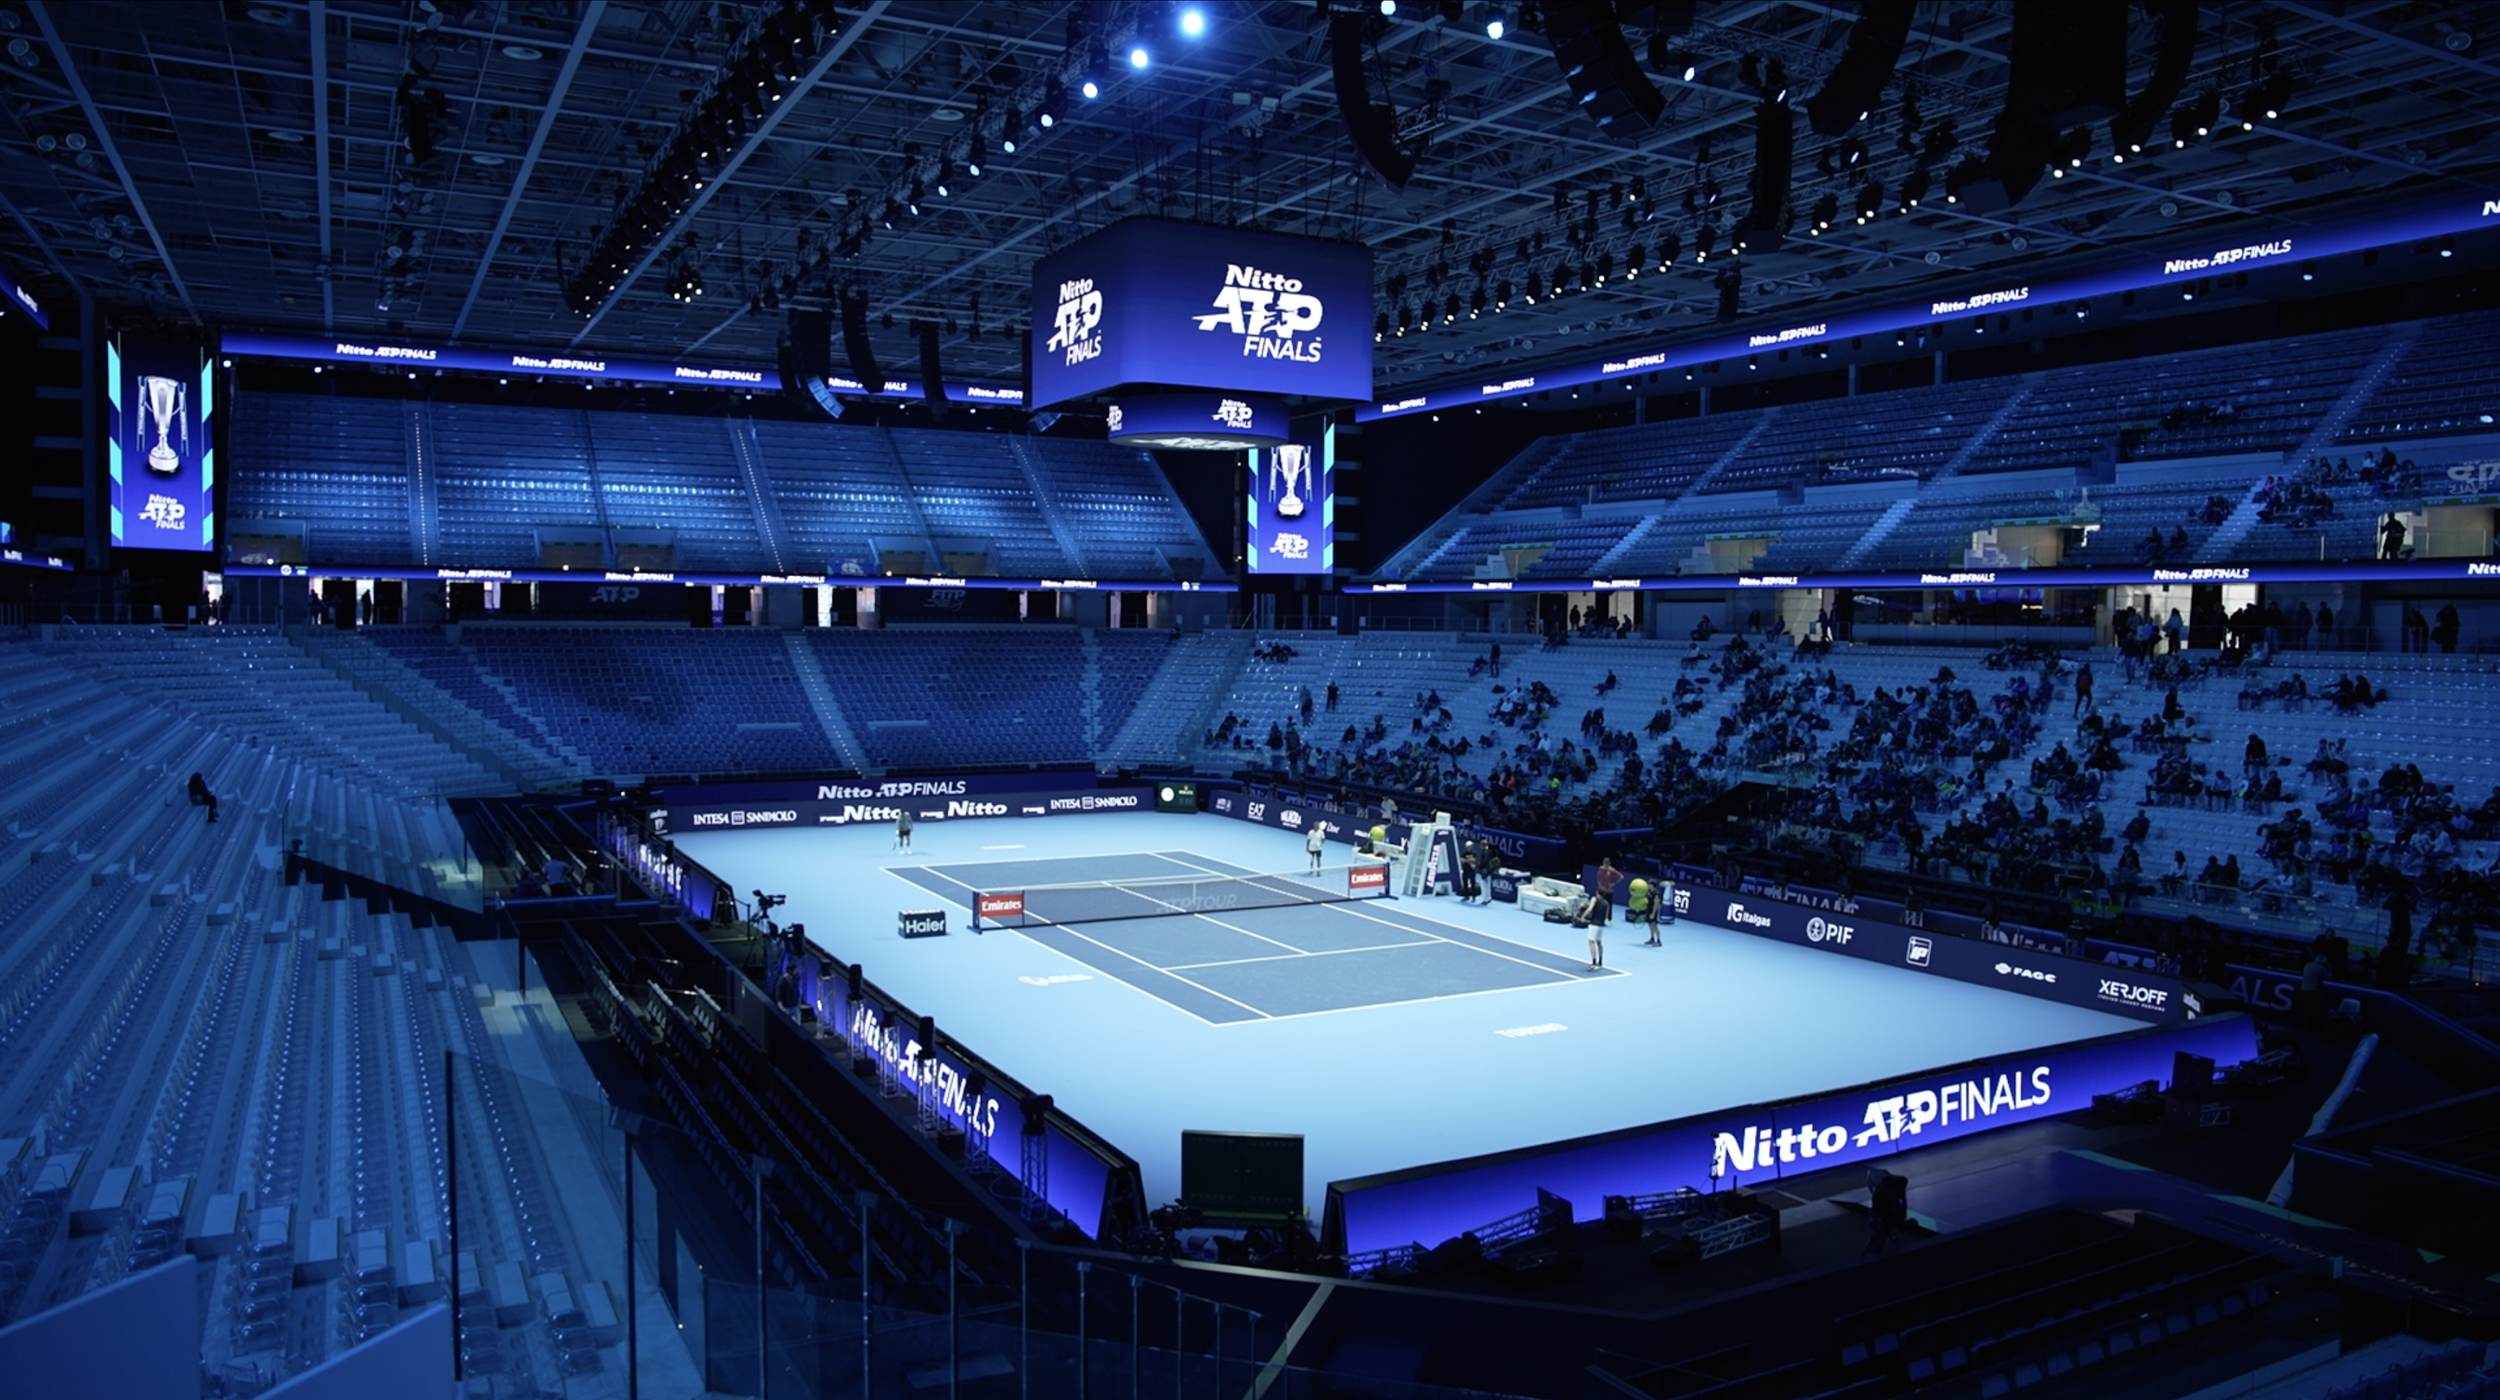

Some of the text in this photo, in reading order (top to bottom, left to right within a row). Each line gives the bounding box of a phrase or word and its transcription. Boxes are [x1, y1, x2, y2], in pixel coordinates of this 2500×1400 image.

[2165, 239, 2291, 275] Nitto ATP FINALS
[1225, 264, 1303, 293] Nitto
[1059, 278, 1094, 304] Nitto
[1932, 287, 2028, 315] Nitto ATP FINALS
[1192, 285, 1324, 338] ATP
[1046, 289, 1103, 353] ATP
[1750, 335, 1777, 348] Nitto
[1798, 323, 1826, 339] FINALS
[336, 343, 437, 360] Nitto ATP FINALS
[1066, 333, 1102, 366] FINALS
[1243, 336, 1322, 363] FINALS
[512, 356, 606, 372] Nitto ATP FINALS
[676, 367, 707, 379] Nitto
[730, 370, 762, 382] FINALS
[884, 381, 908, 392] NALS
[1212, 406, 1253, 421] ATP
[149, 494, 178, 504] Nitto
[138, 503, 186, 521] ATP
[155, 519, 185, 530] FINALS
[438, 569, 465, 578] Nitto
[484, 570, 511, 579] FINALS
[606, 572, 632, 581] Nitto
[650, 573, 674, 582] FINALS
[1921, 574, 1948, 584] Nitto
[1967, 572, 1995, 583] FINALS
[2154, 568, 2249, 580] Nitto ATP FINALS
[591, 586, 640, 602] ATP
[931, 589, 966, 600] FITP
[818, 780, 966, 799] Nitto ATP FINALS
[948, 801, 1007, 817] Nitto
[1051, 799, 1081, 810] INTESA
[1248, 801, 1265, 817] EA7
[694, 813, 729, 825] INTESA
[844, 805, 900, 821] Nitto
[1351, 870, 1384, 884] Emirates
[981, 899, 1022, 912] Emirates
[1197, 894, 1237, 910] TOUR
[905, 918, 946, 934] Haier
[1826, 923, 1854, 945] PIF
[2099, 979, 2168, 1005] XERJOFF
[2224, 973, 2296, 1012] ALS
[1711, 1067, 2051, 1177] Nitto ATP FINALS
